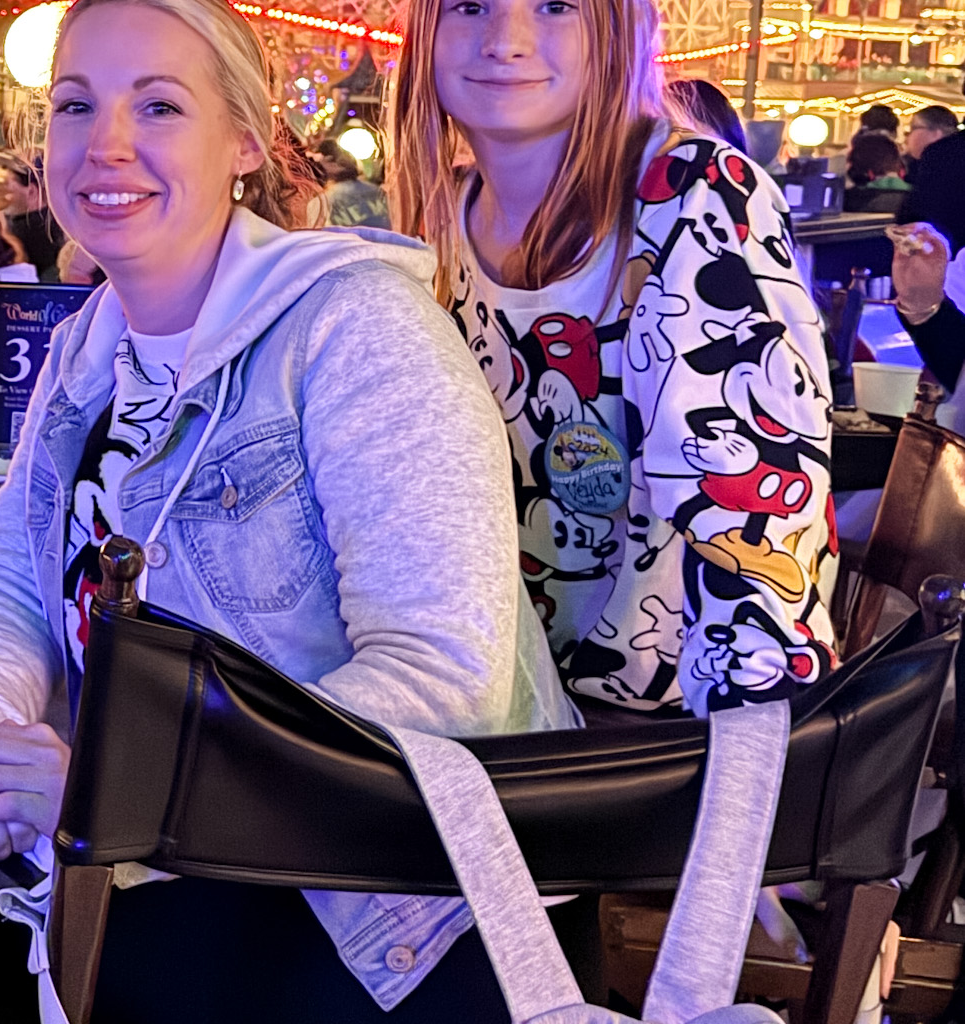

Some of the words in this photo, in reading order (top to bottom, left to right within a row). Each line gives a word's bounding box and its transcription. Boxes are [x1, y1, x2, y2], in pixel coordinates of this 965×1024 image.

[1, 302, 38, 322] World
[6, 324, 41, 333] DESSERT
[0, 337, 51, 383] 3
[551, 474, 581, 485] Happy
